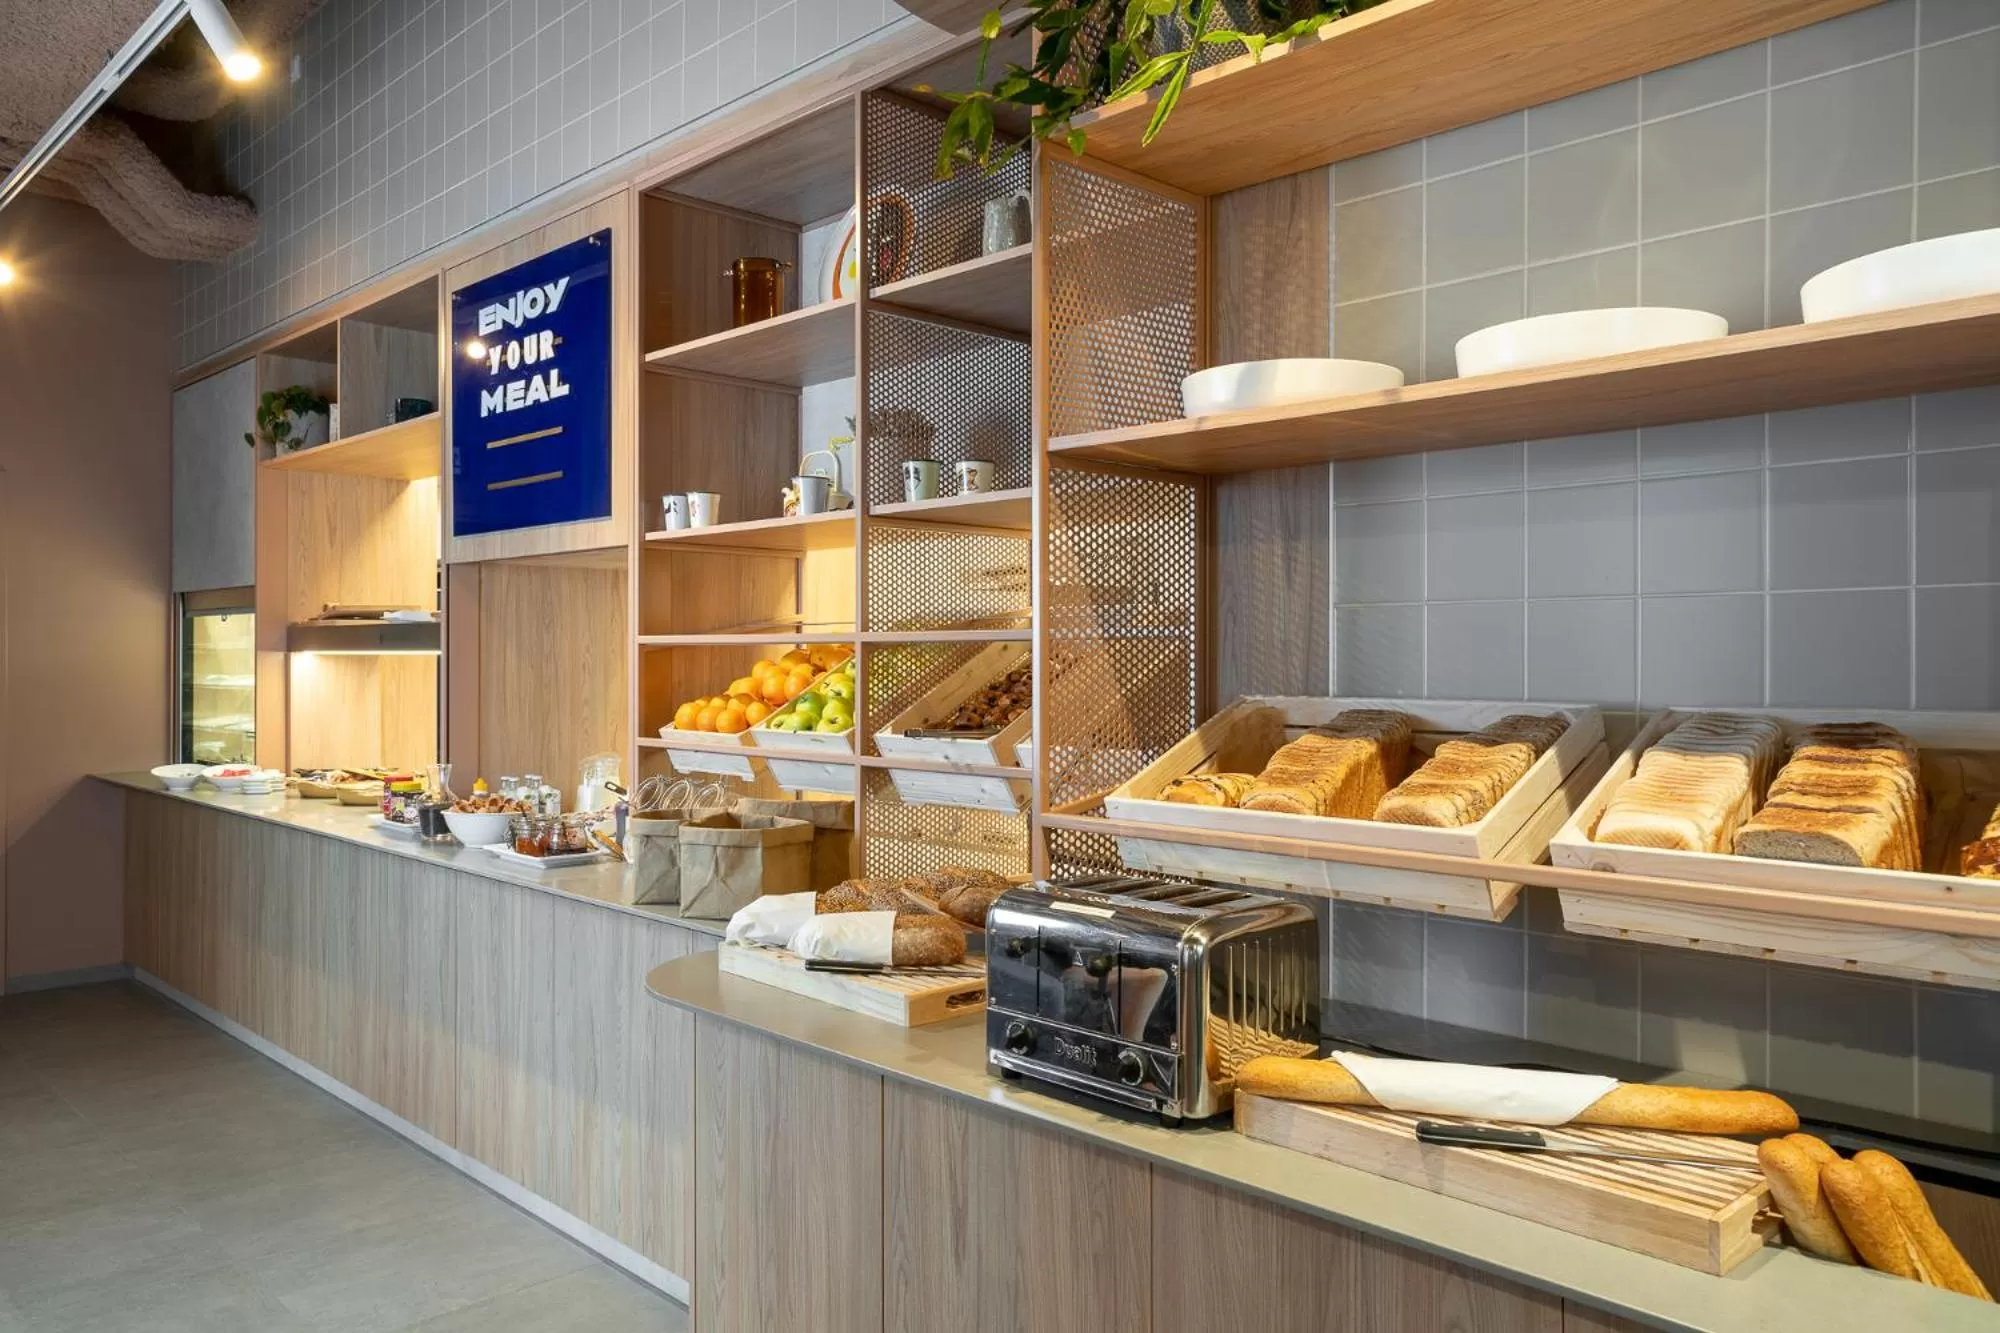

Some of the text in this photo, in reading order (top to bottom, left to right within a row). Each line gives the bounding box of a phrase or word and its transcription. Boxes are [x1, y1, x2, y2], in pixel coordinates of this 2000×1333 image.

[478, 277, 569, 337] ENJOY
[490, 330, 554, 375] YOUR
[481, 369, 570, 418] MEAL
